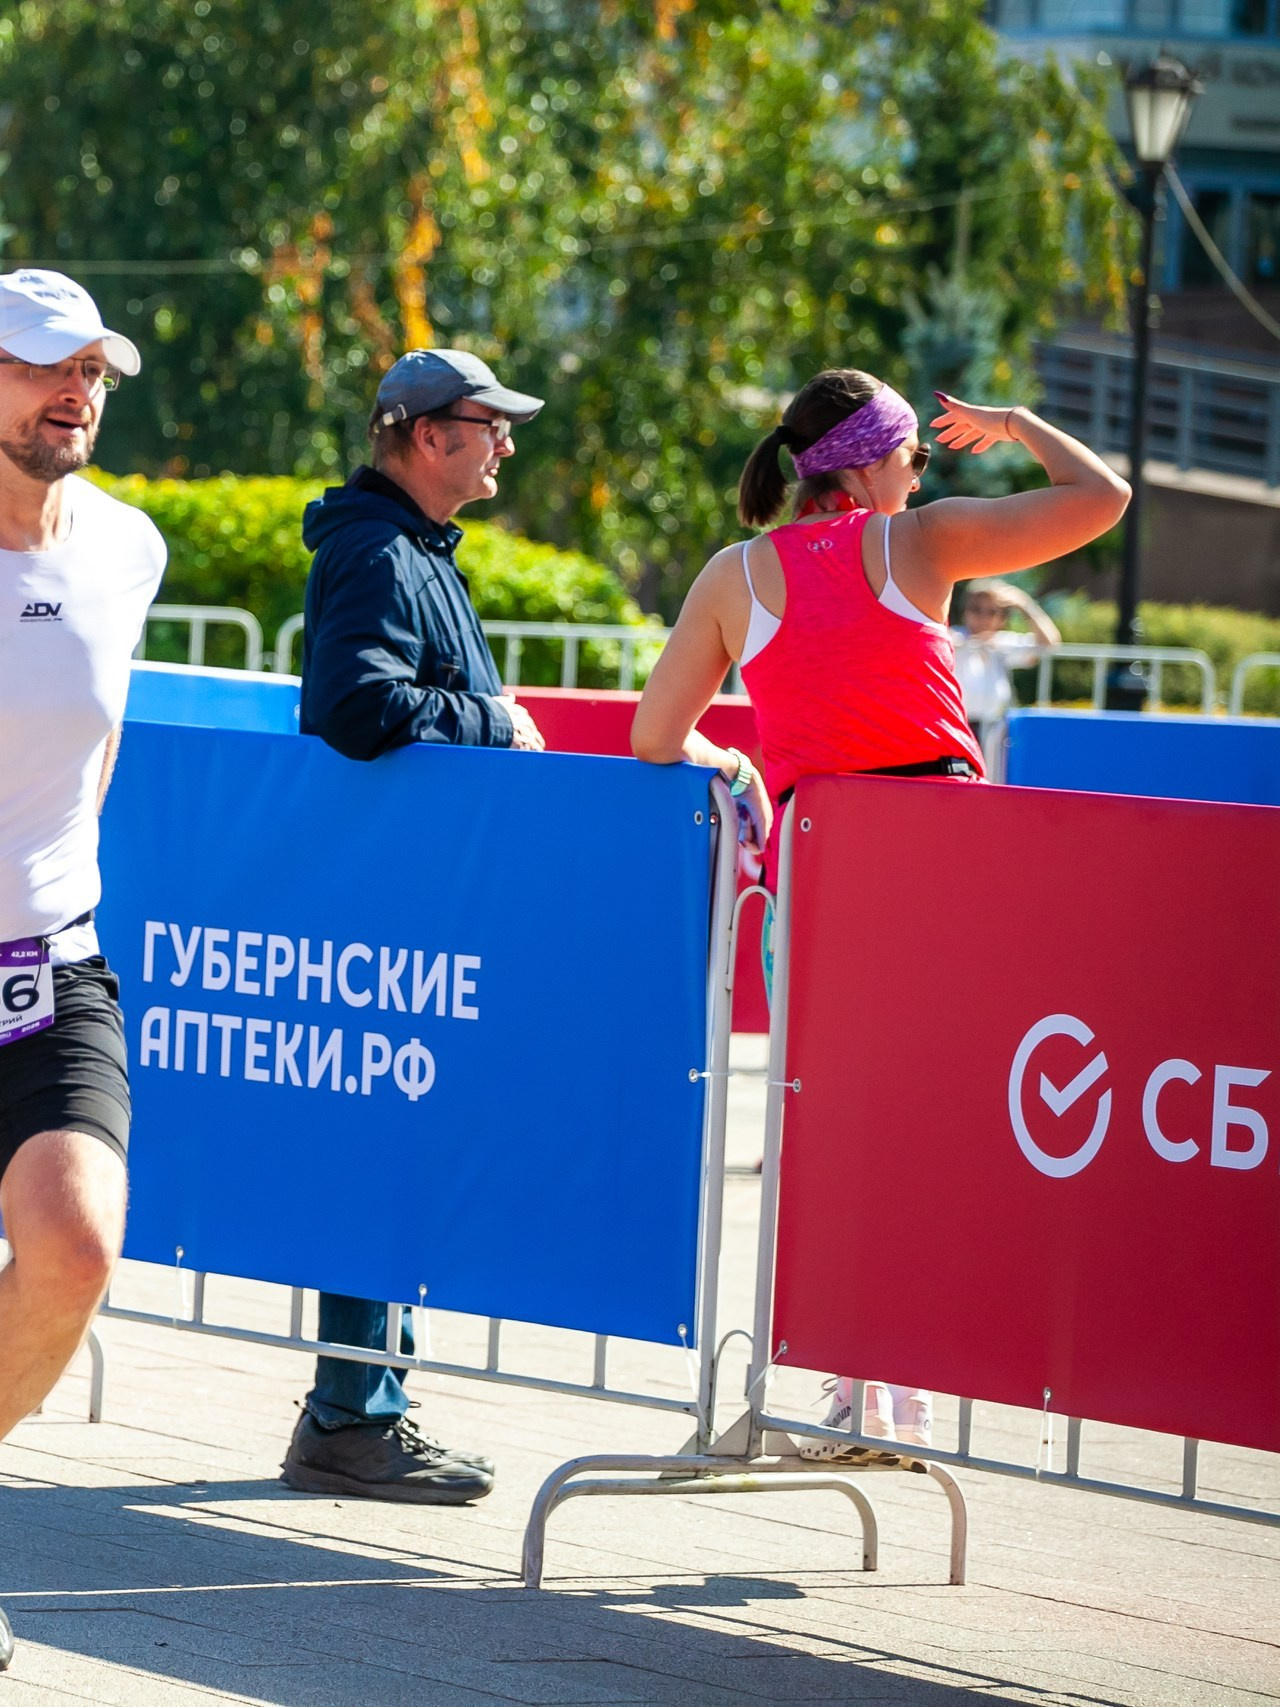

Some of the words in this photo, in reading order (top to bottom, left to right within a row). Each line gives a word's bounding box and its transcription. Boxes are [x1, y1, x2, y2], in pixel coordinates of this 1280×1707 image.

[26, 950, 39, 958] КМ
[142, 919, 482, 1021] ГУБЕРНСКИЕ
[139, 1005, 436, 1102] АПТЕКИ.РФ
[1141, 1057, 1280, 1177] СБ
